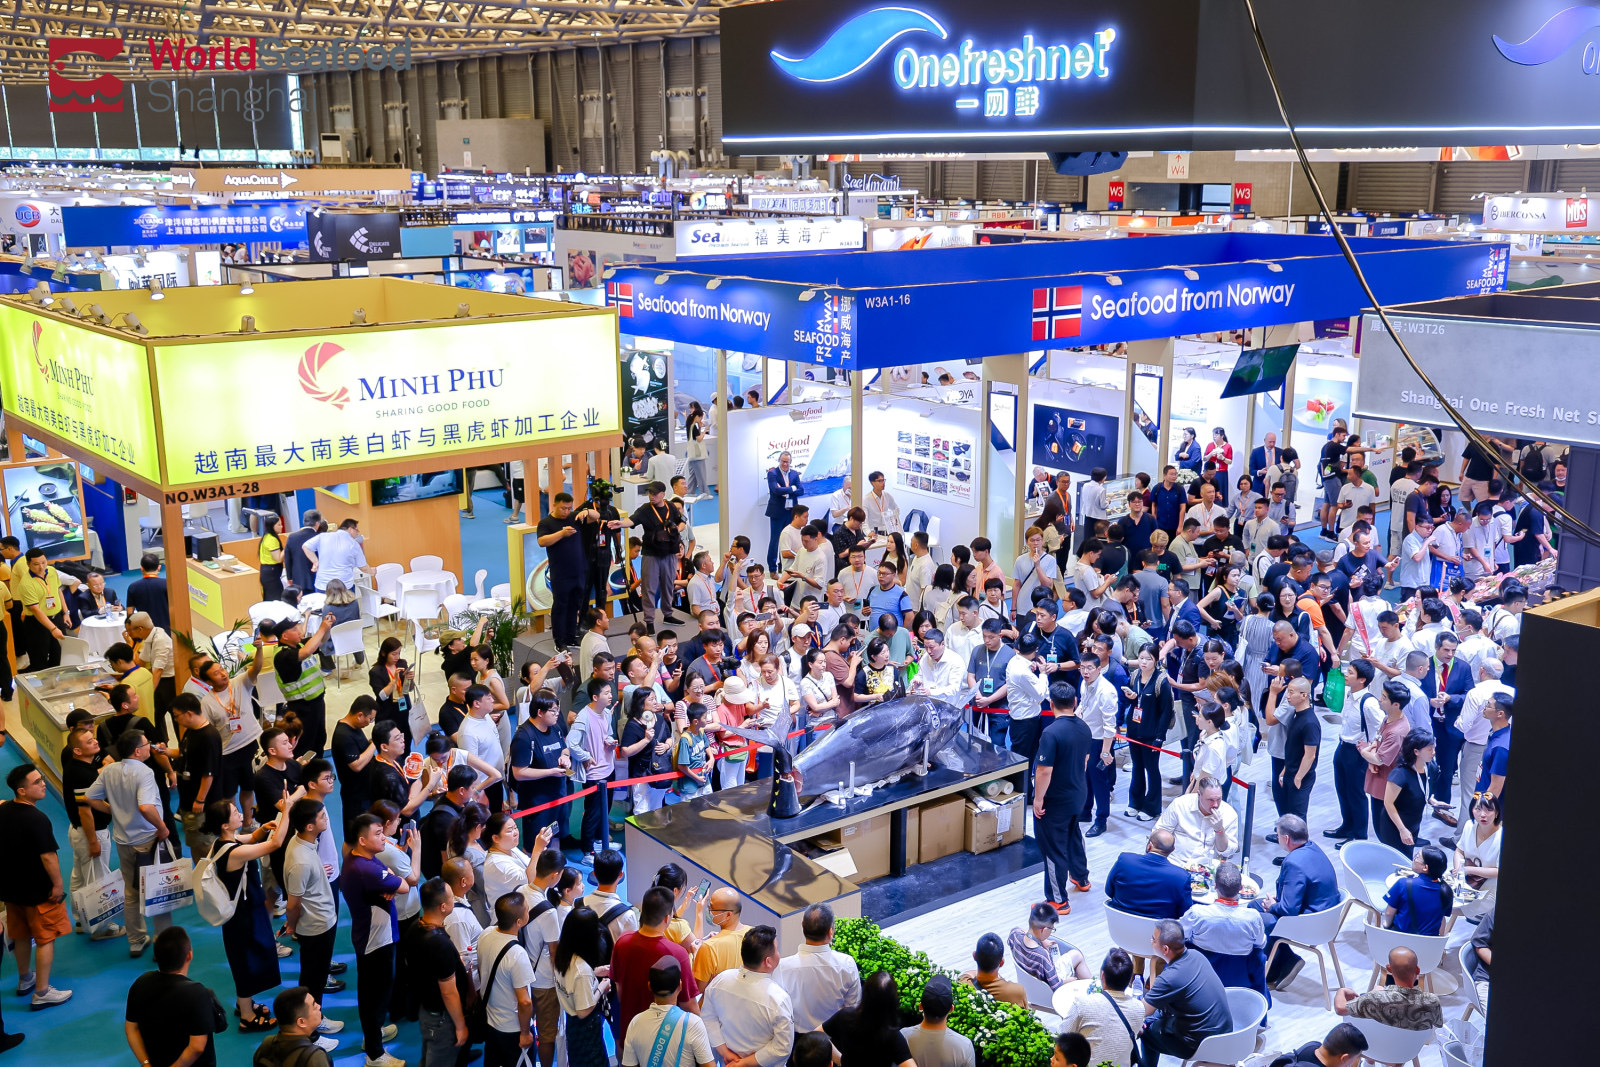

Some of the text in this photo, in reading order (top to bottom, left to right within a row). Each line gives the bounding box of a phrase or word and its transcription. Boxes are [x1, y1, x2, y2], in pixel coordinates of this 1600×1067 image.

[894, 28, 1116, 90] Onefreshnet
[955, 86, 1039, 117] 一网鲜
[1171, 165, 1185, 175] W4
[1109, 186, 1123, 197] W3
[1235, 188, 1251, 199] W3
[15, 210, 41, 220] UCB
[754, 226, 832, 246] 禧美海产
[1465, 277, 1496, 290] SEAFOOD
[637, 291, 771, 331] Seafood from Norway
[864, 293, 911, 309] W3A1-16
[1090, 284, 1295, 320] Seafood from Norway
[793, 329, 840, 347] SEAFOOD
[358, 368, 504, 402] MINH PHU
[375, 398, 490, 419] SHARING GOOD FOOD
[1469, 397, 1499, 413] One
[1504, 401, 1546, 420] Fresh
[1552, 407, 1580, 424] Net
[194, 407, 601, 476] 越南最大南美白虾与黑虎虾加工企业
[768, 434, 810, 451] Seafood
[164, 481, 260, 506] NO.W3A1-28
[652, 1037, 666, 1067] DONGF
